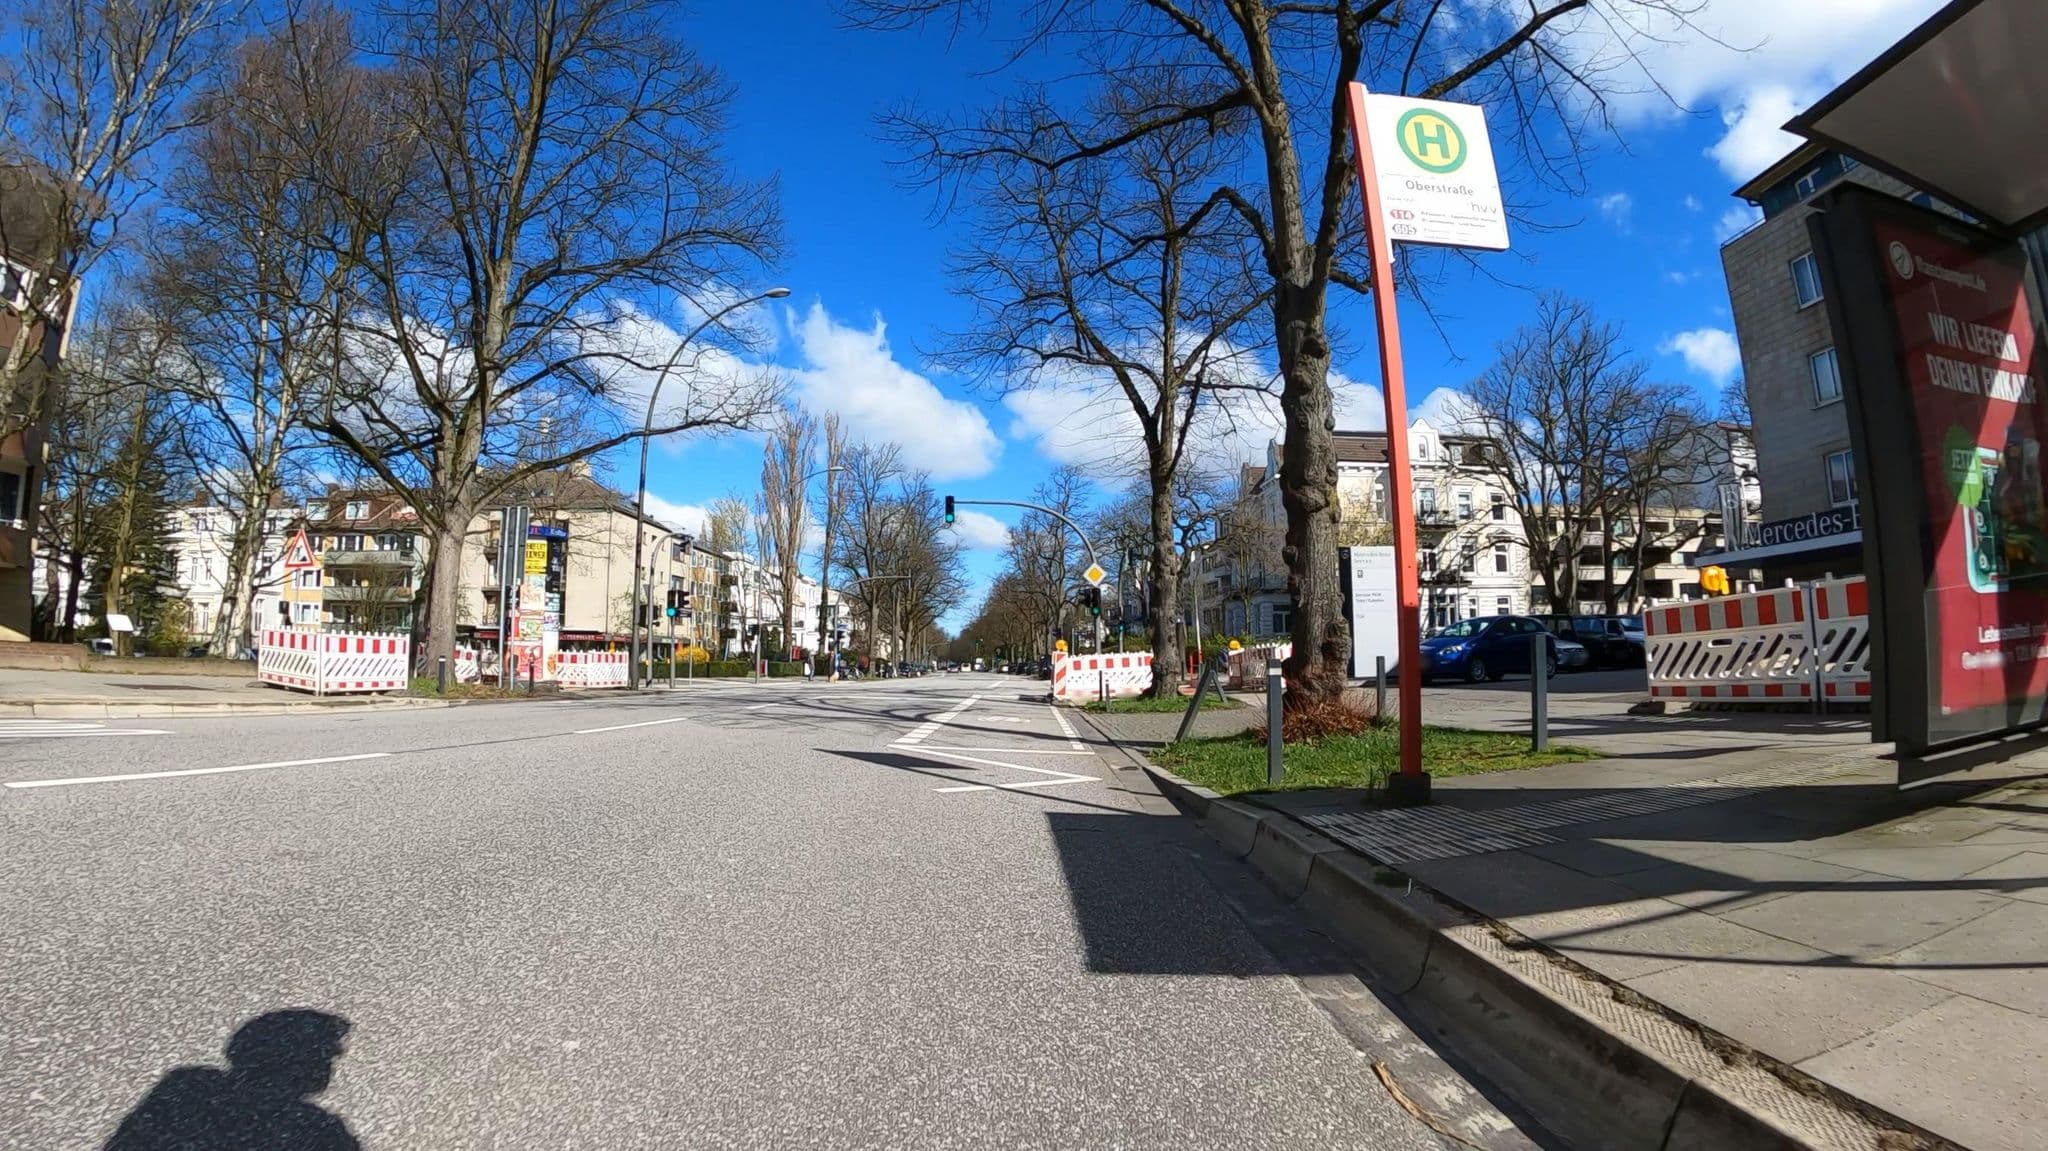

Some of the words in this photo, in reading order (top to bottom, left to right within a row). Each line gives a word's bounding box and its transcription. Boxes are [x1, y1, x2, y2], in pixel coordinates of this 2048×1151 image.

[1414, 121, 1451, 159] H
[1405, 179, 1474, 196] Oberstraße
[1927, 311, 1963, 349] WIR
[1925, 352, 1980, 395] DEINEN
